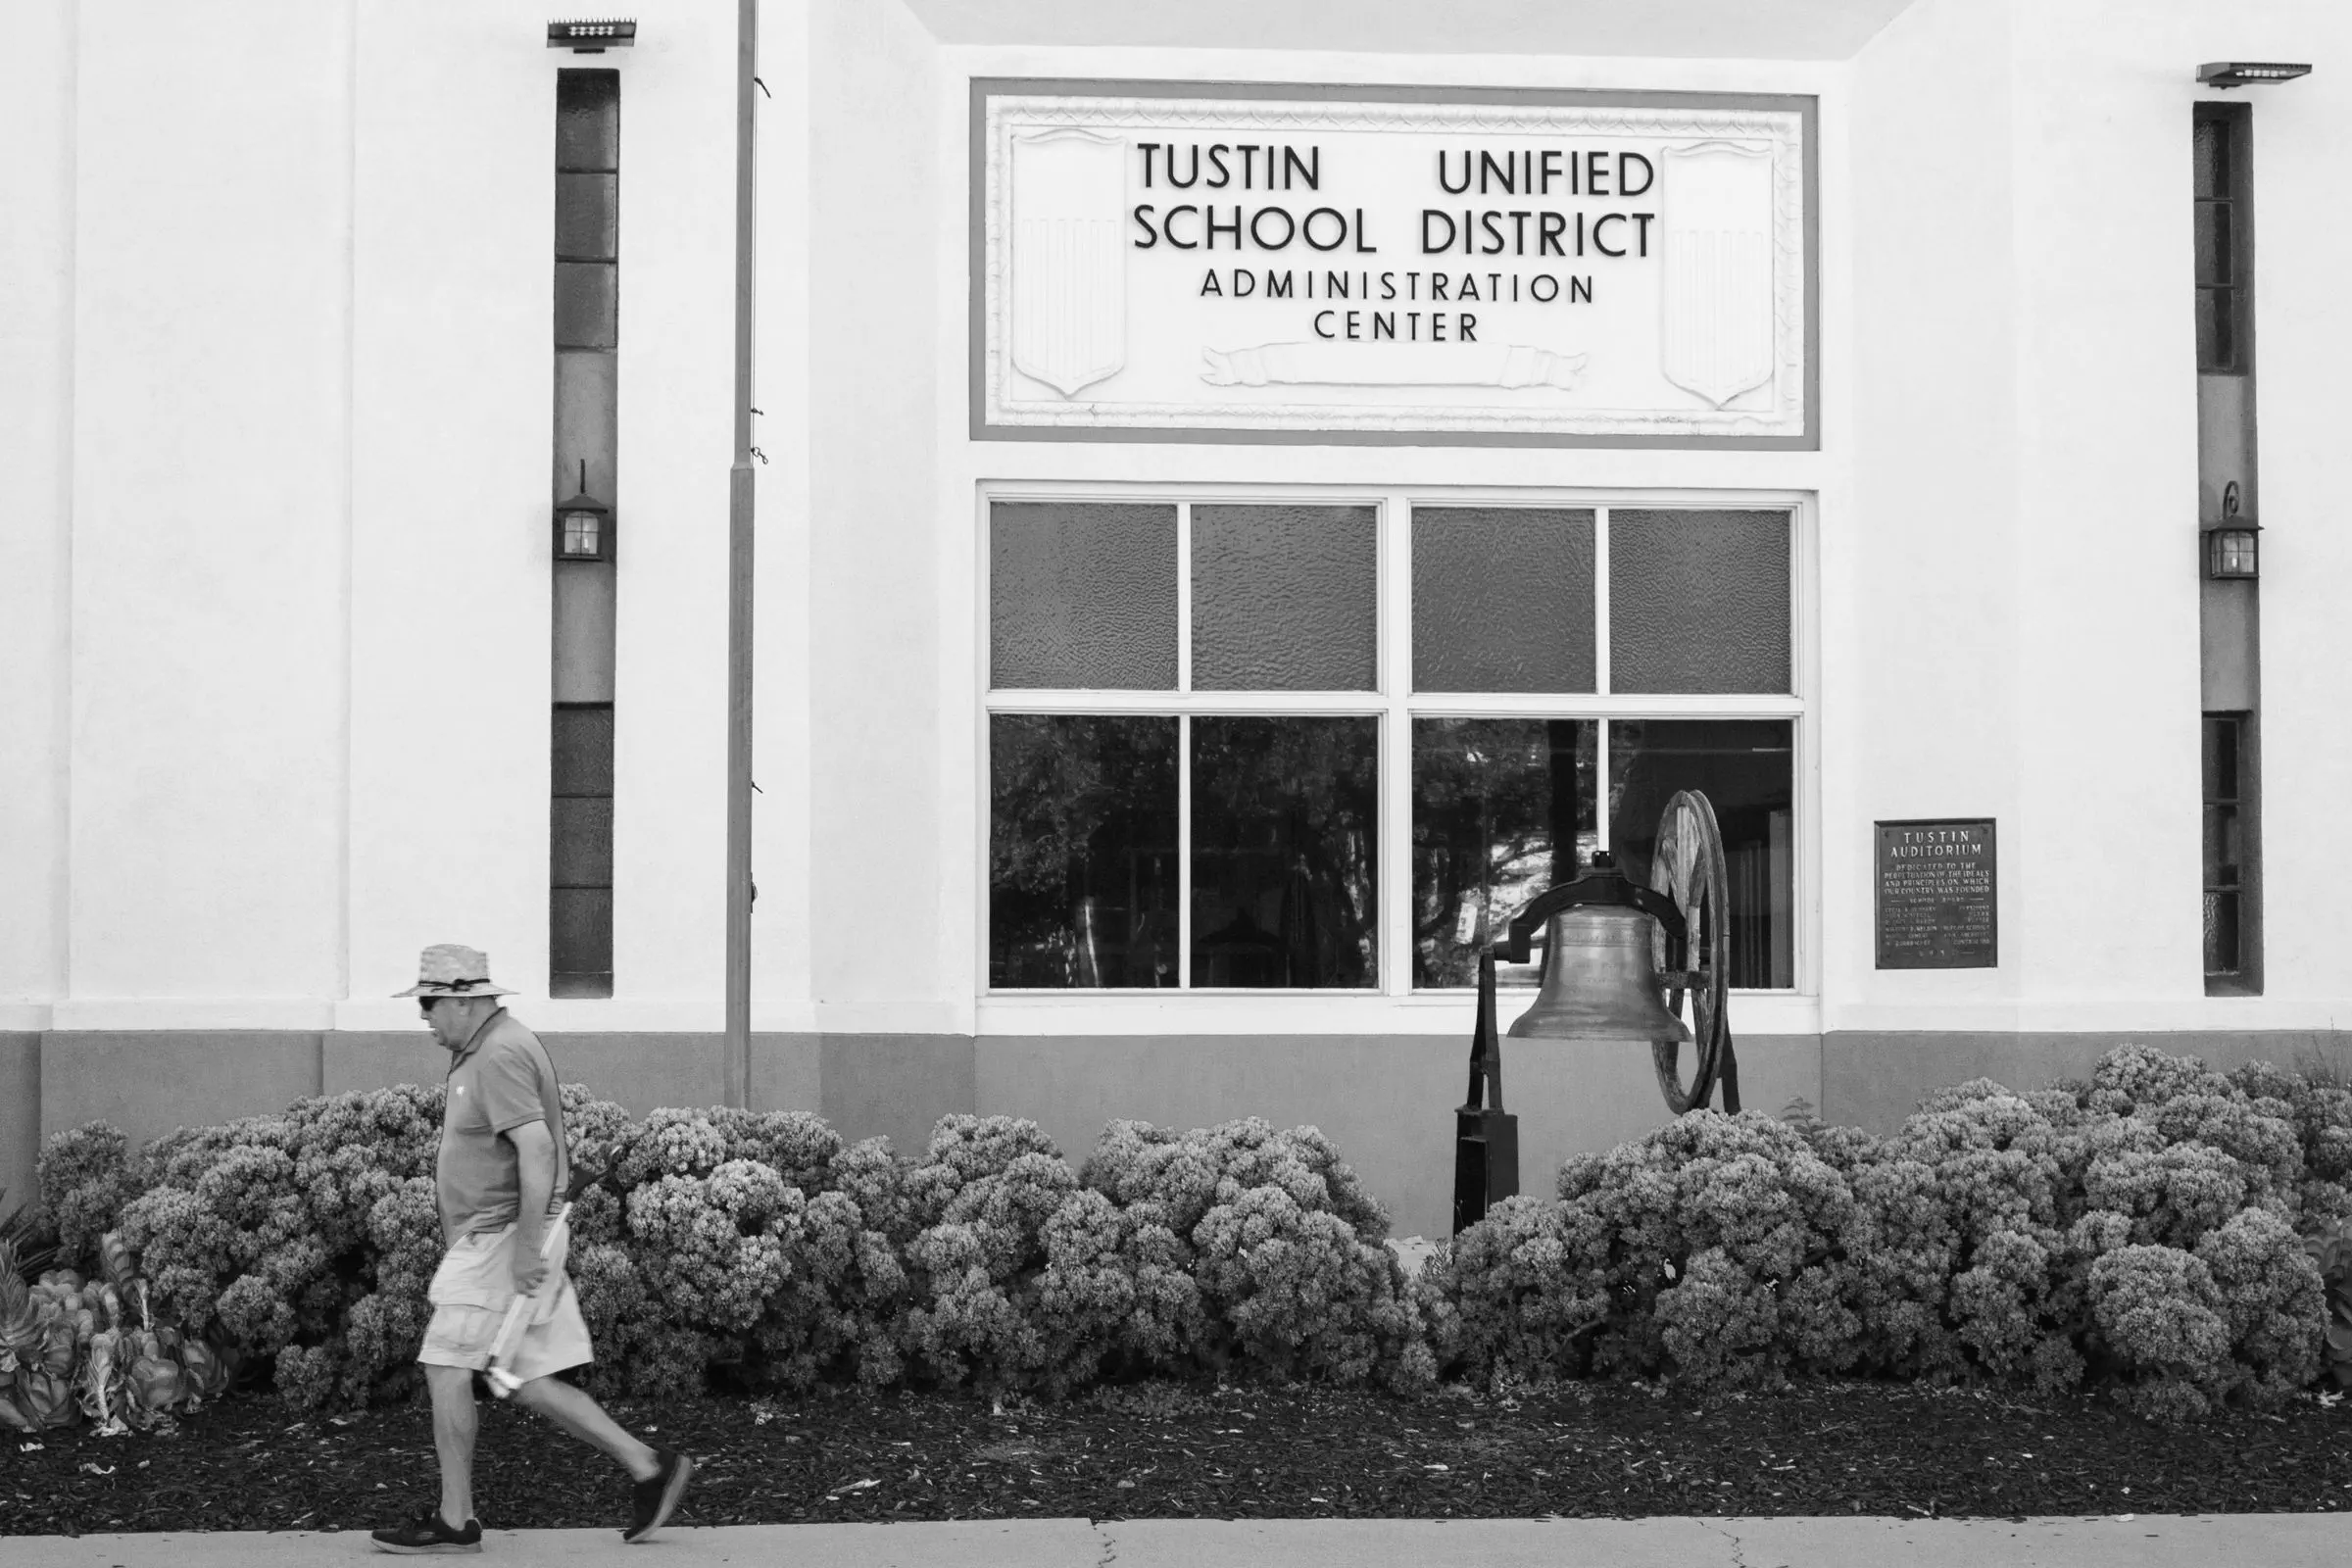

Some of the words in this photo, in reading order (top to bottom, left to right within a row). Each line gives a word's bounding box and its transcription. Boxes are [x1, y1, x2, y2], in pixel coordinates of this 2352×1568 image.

[1137, 143, 1319, 190] TUSTIN
[1438, 150, 1654, 197] UNIFIED
[1133, 204, 1377, 253] SCHOOL
[1421, 209, 1655, 258] DISTRICT
[1200, 269, 1592, 304] ADMINISTRATION
[1313, 310, 1477, 342] CENTER
[1890, 844, 1982, 858] AUDITORIUM
[1904, 830, 1969, 844] TUSTIN
[1960, 861, 1976, 870] THE
